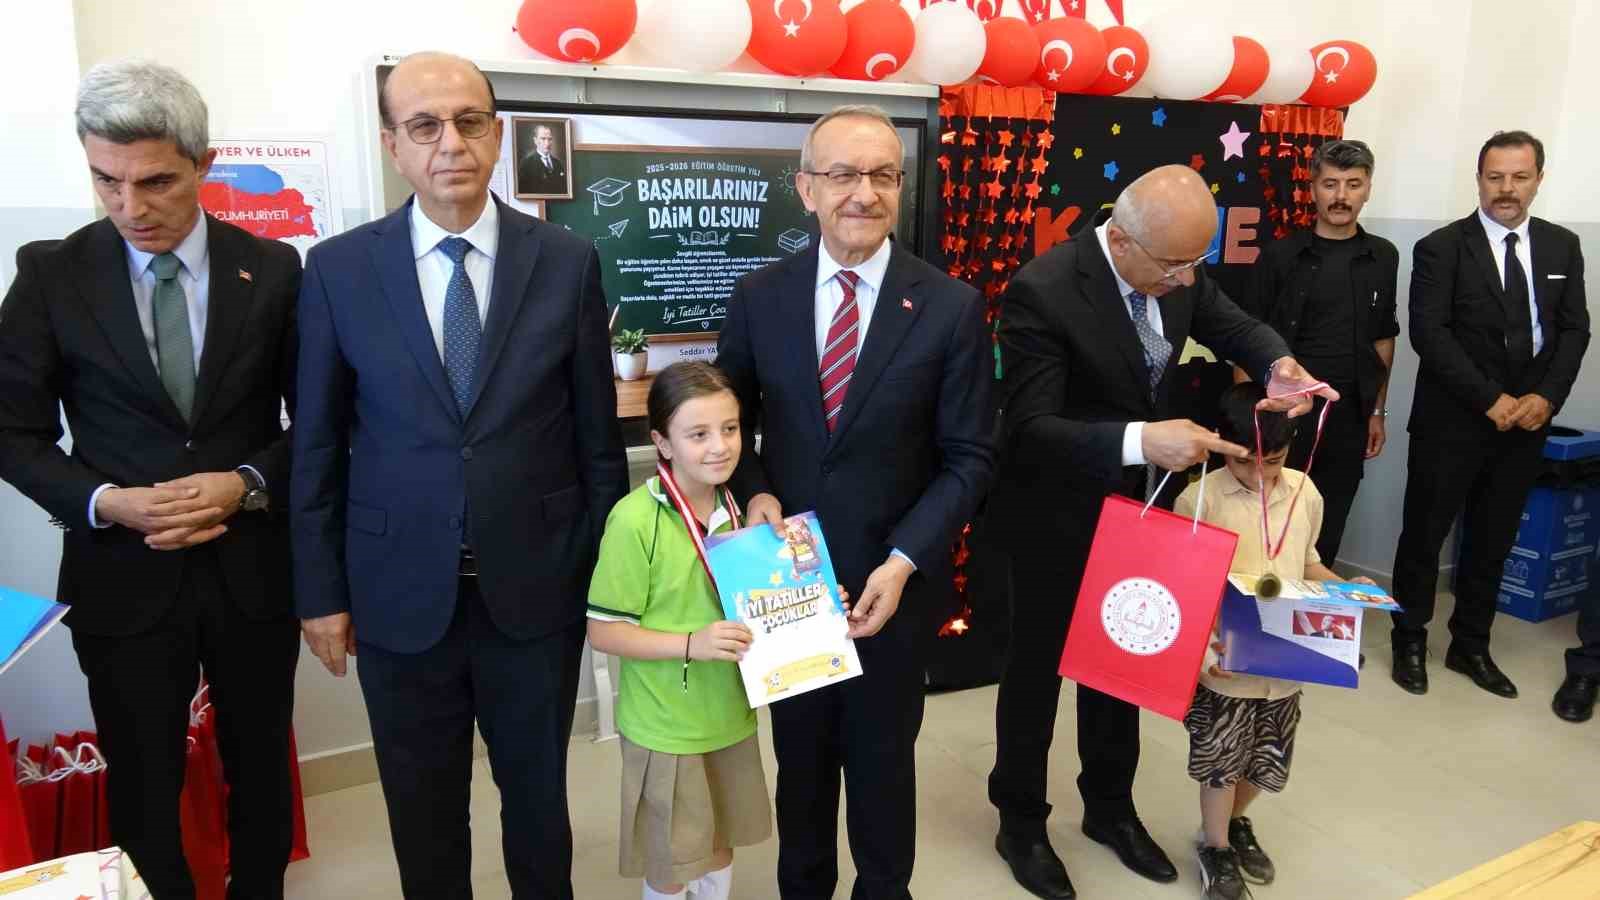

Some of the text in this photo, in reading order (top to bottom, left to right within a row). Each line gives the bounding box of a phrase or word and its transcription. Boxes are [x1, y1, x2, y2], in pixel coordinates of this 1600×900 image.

[216, 144, 311, 157] YER VE ÜLKEM
[637, 178, 769, 205] BAŞARILARINIZ
[698, 206, 760, 229] OLSUN!
